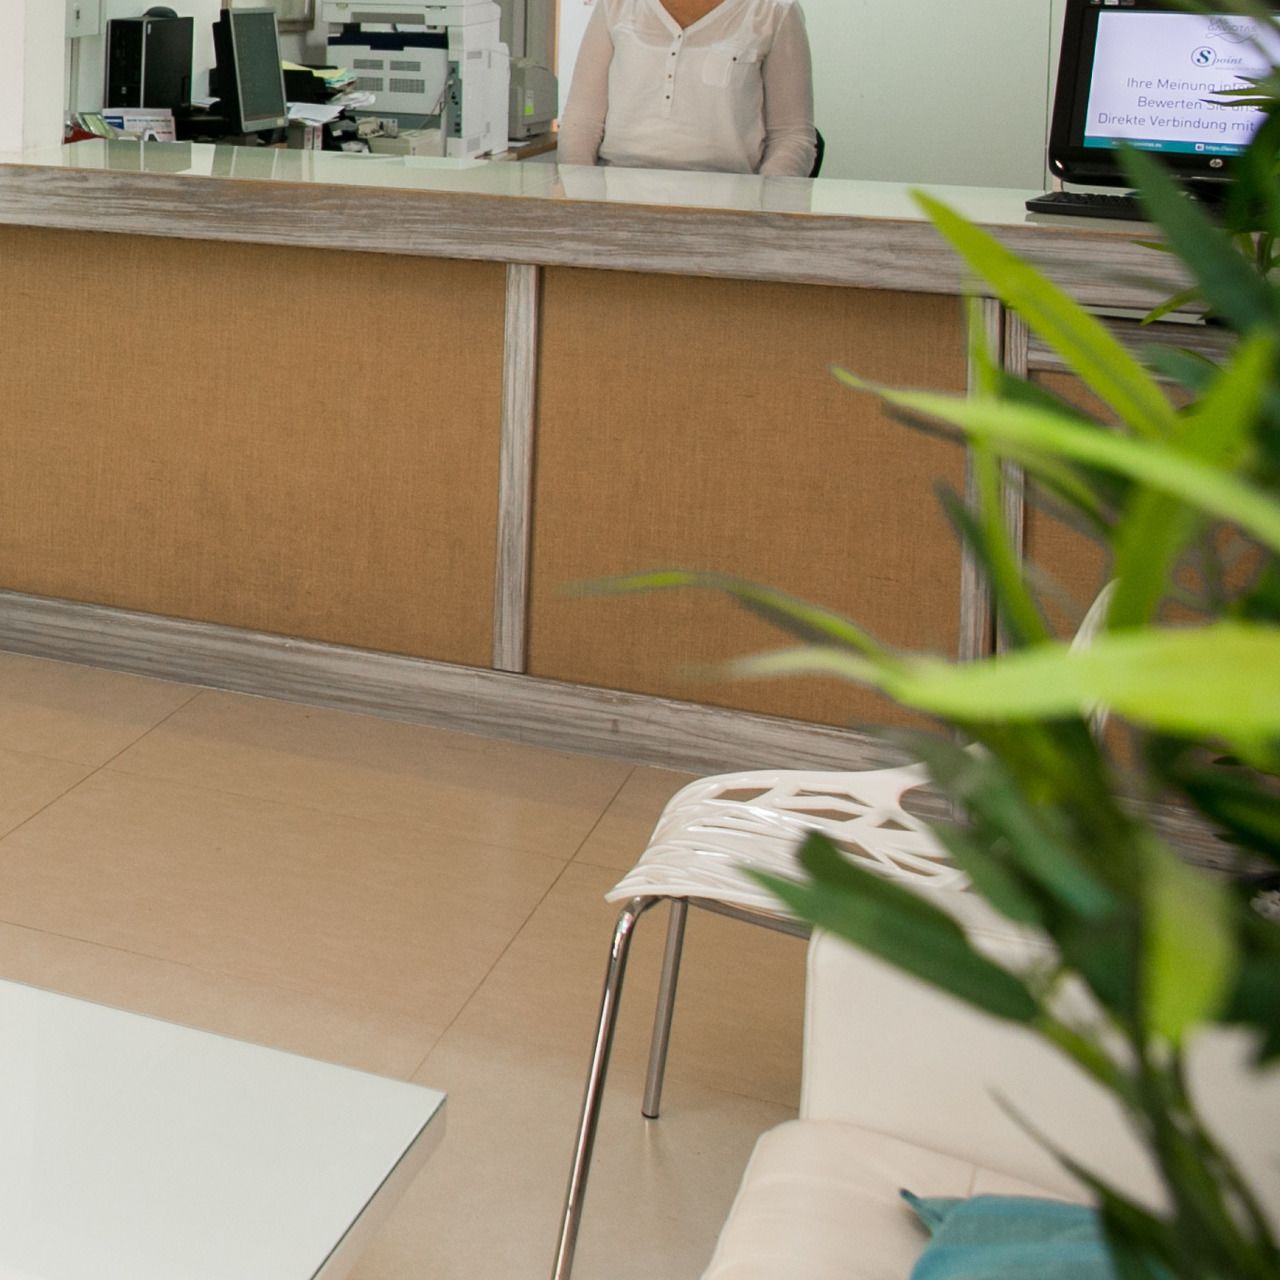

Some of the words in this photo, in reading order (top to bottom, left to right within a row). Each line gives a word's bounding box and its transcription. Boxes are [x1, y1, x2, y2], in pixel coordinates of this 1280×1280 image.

[1127, 77, 1152, 89] Ihre
[1157, 78, 1215, 93] Meinung
[1137, 96, 1202, 110] Bewerten
[1098, 112, 1146, 126] Direkte
[1150, 116, 1227, 133] Verbindung
[1232, 121, 1256, 131] mit
